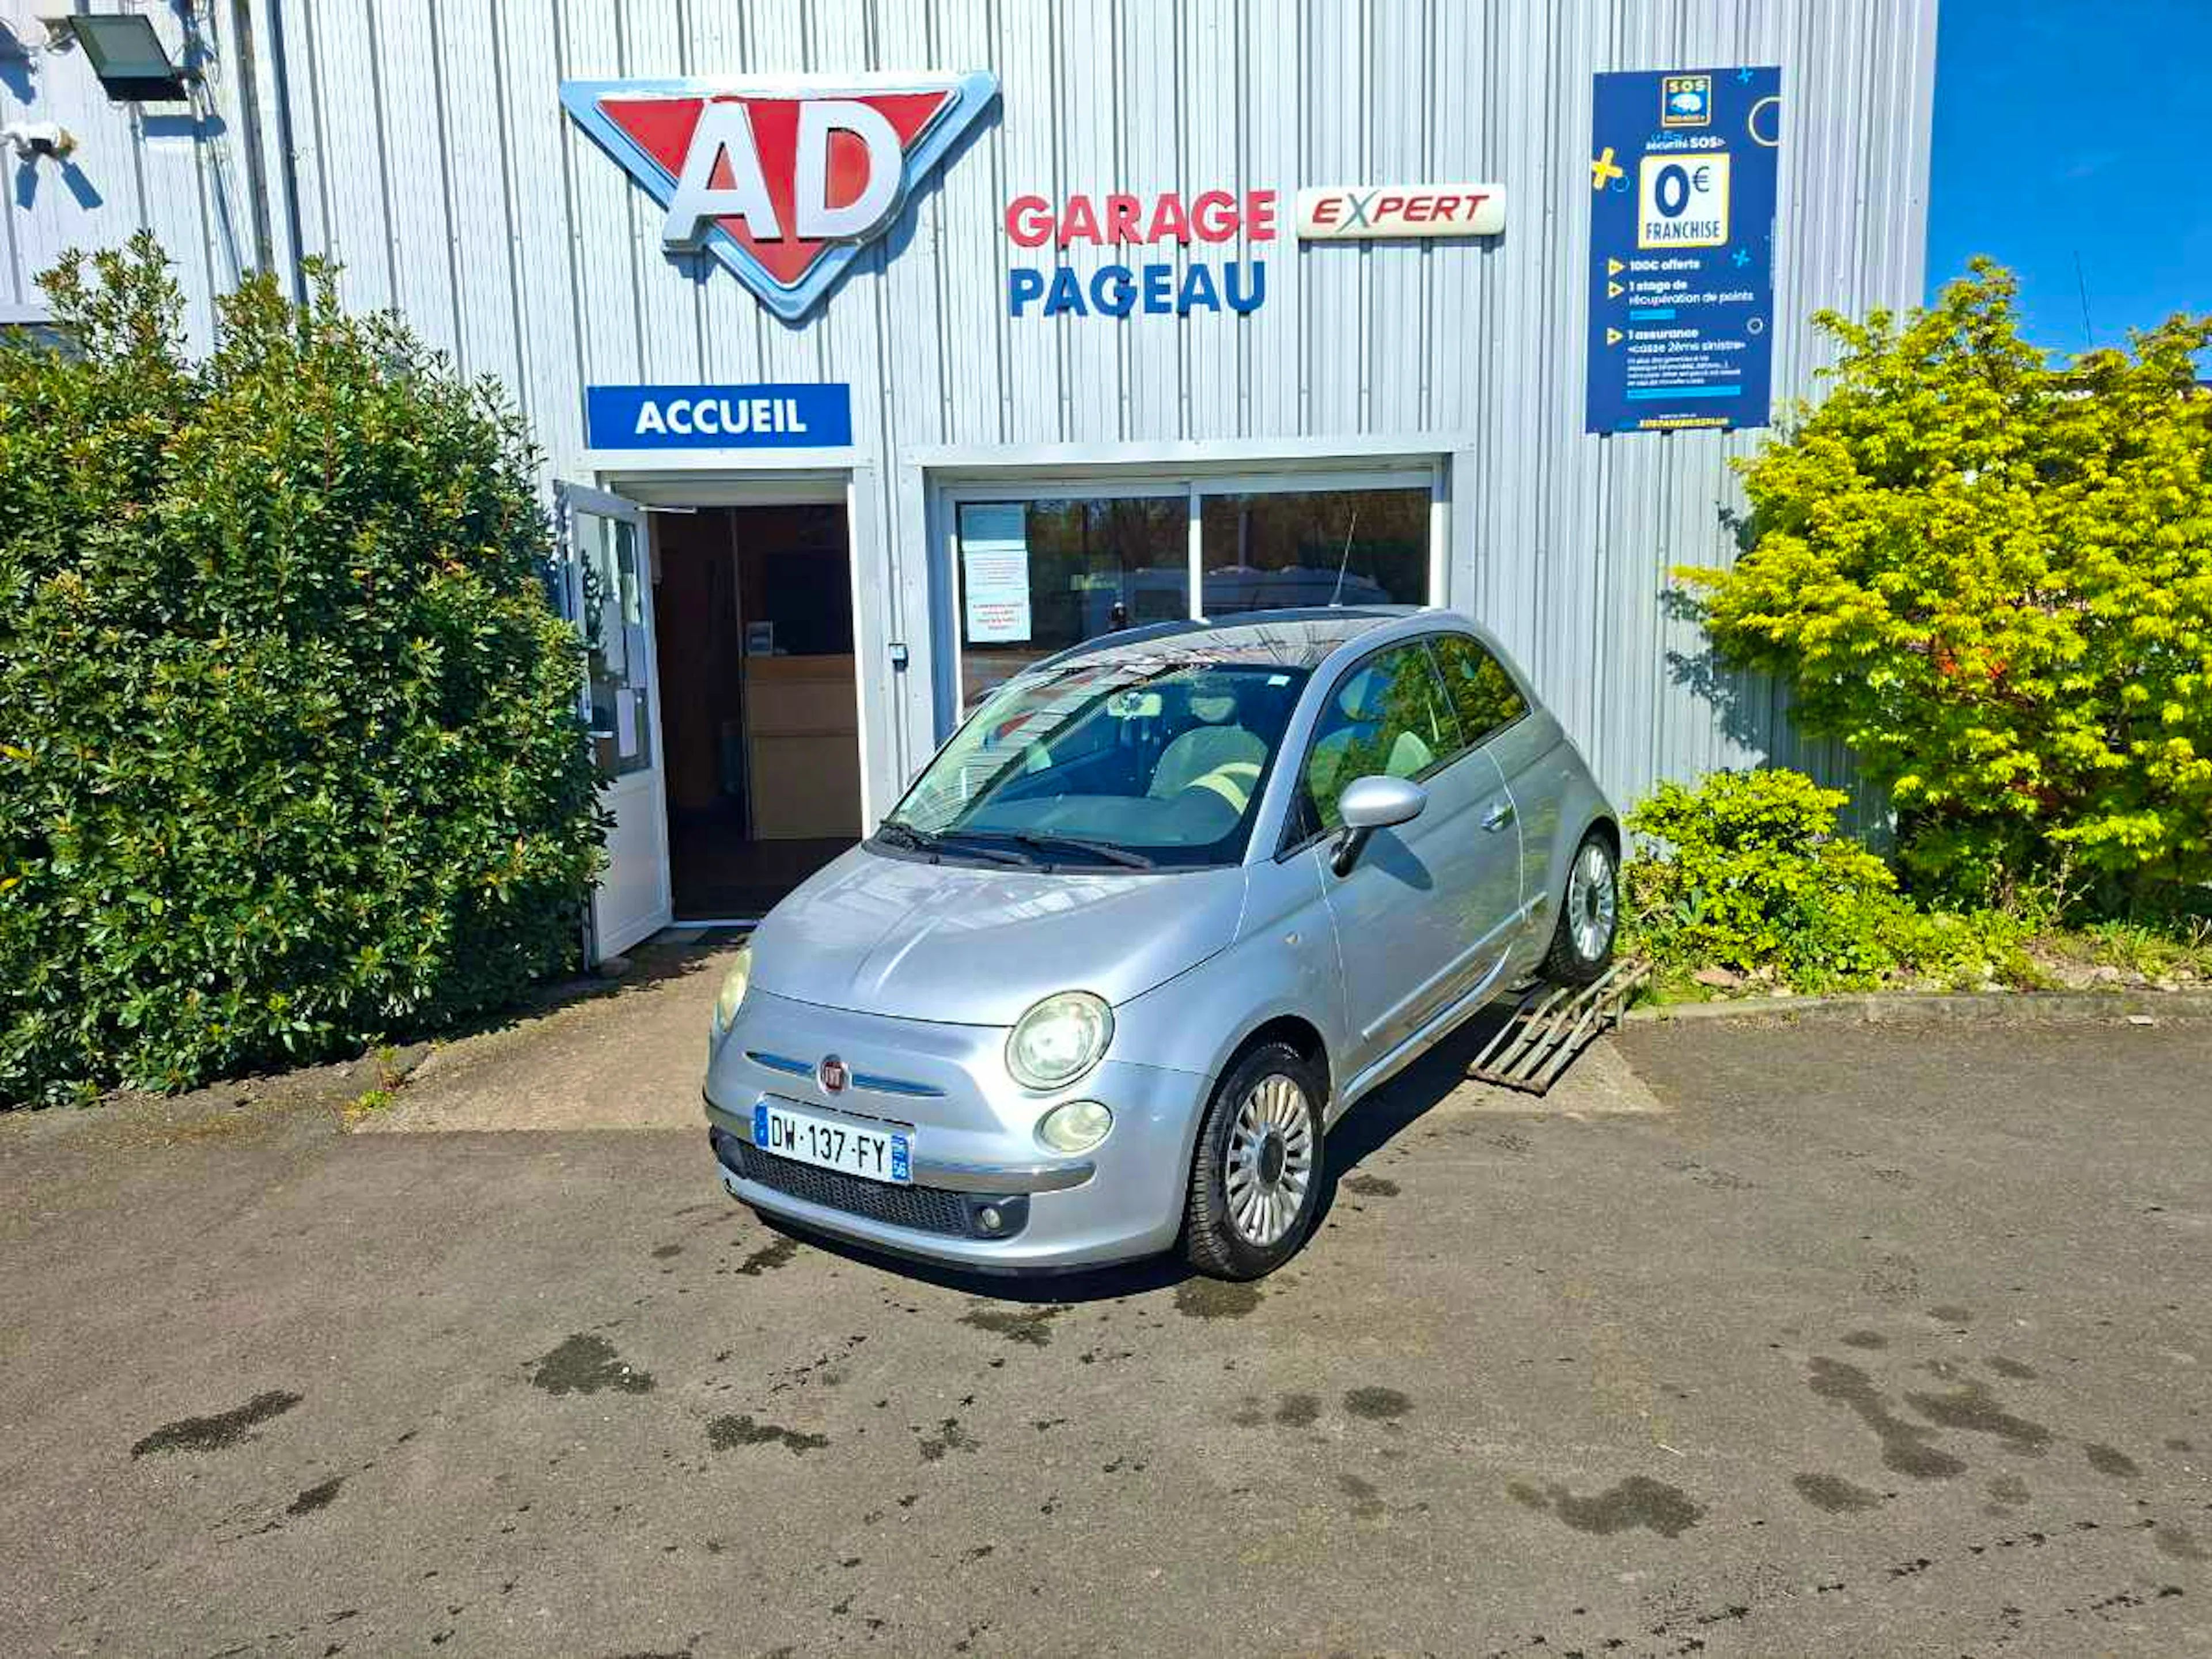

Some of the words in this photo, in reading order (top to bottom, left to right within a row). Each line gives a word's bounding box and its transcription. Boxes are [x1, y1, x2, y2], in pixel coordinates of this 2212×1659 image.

[1668, 80, 1708, 93] SOS
[662, 99, 904, 243] AD
[1004, 189, 1277, 247] GARAGE
[1311, 194, 1489, 232] EXPERT
[1646, 221, 1721, 240] FRANCHISE
[1661, 259, 1700, 270] offerts
[1007, 262, 1265, 317] PAGEAU
[1629, 281, 1634, 291] 1
[1636, 281, 1670, 293] stage
[1673, 280, 1687, 289] de
[1629, 293, 1700, 306] récupération
[1719, 290, 1753, 305] points
[1635, 329, 1699, 340] assurance
[634, 398, 806, 435] ACCUEIL
